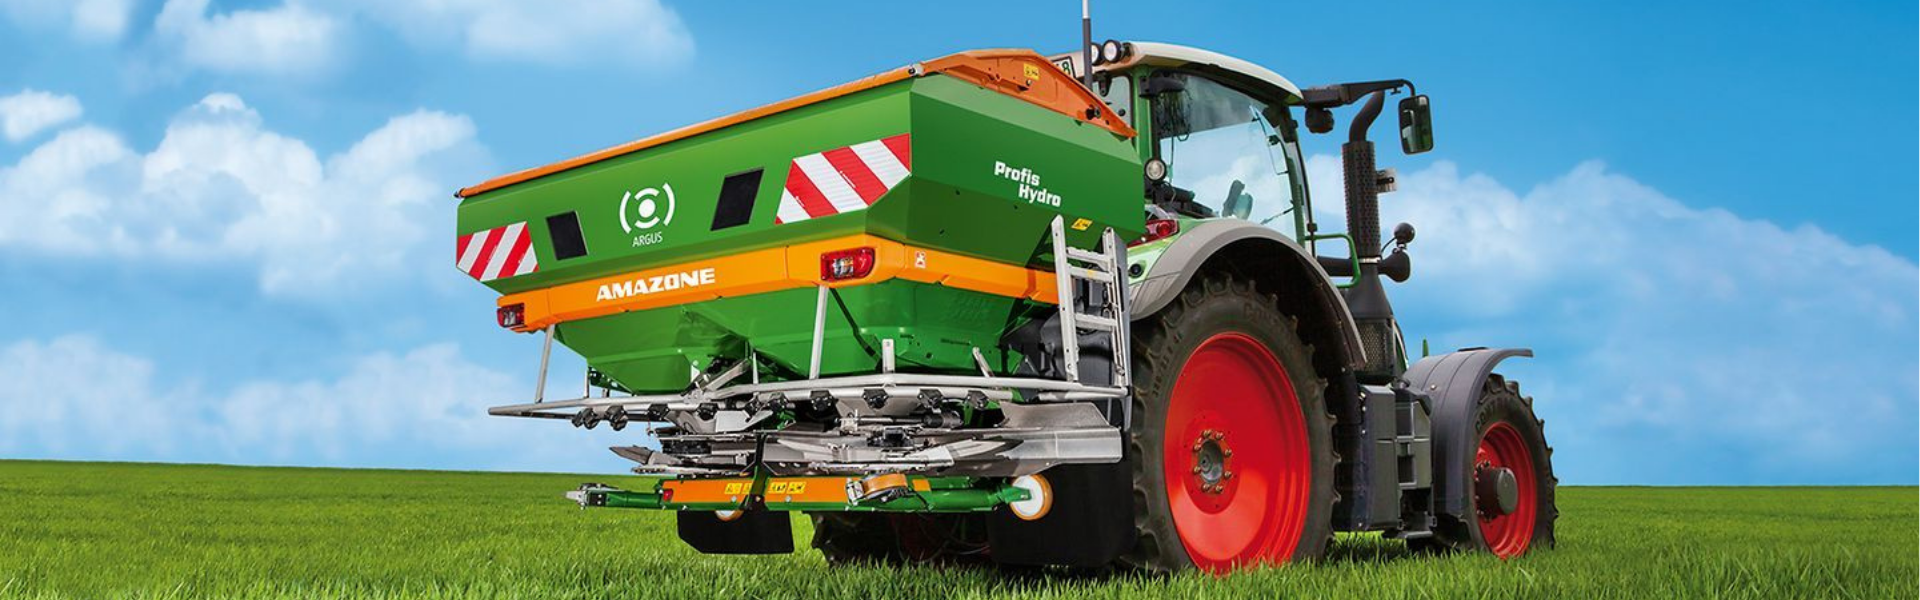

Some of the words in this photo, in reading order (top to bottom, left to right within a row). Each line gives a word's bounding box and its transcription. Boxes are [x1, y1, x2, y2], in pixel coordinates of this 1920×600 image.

[994, 160, 1041, 187] Profis
[1018, 183, 1062, 208] Hydro
[632, 231, 663, 248] ARGUS
[596, 267, 715, 302] AMAZONE
